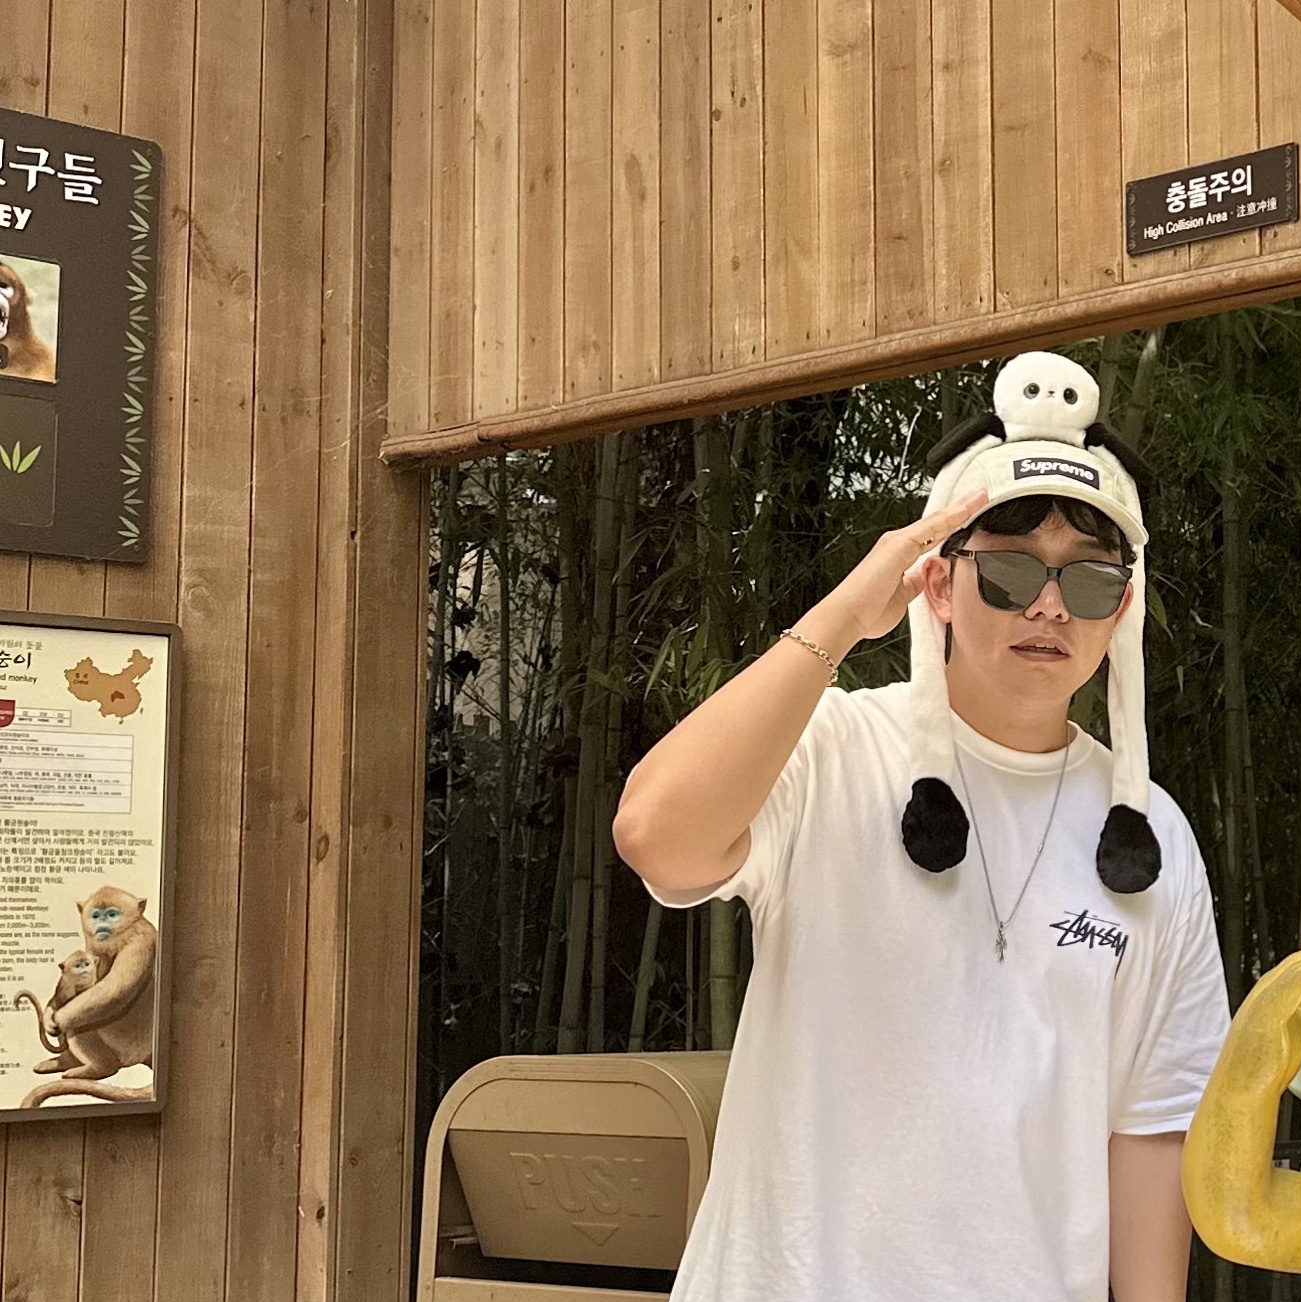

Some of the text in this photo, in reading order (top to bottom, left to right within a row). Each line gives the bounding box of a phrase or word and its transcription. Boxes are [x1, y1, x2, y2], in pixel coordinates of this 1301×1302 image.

[1166, 165, 1252, 213] 충돌주의
[1143, 210, 1228, 240] High Collision Area
[1020, 459, 1095, 481] Supreme
[9, 675, 38, 685] monkey
[509, 1151, 661, 1219] PUSH
